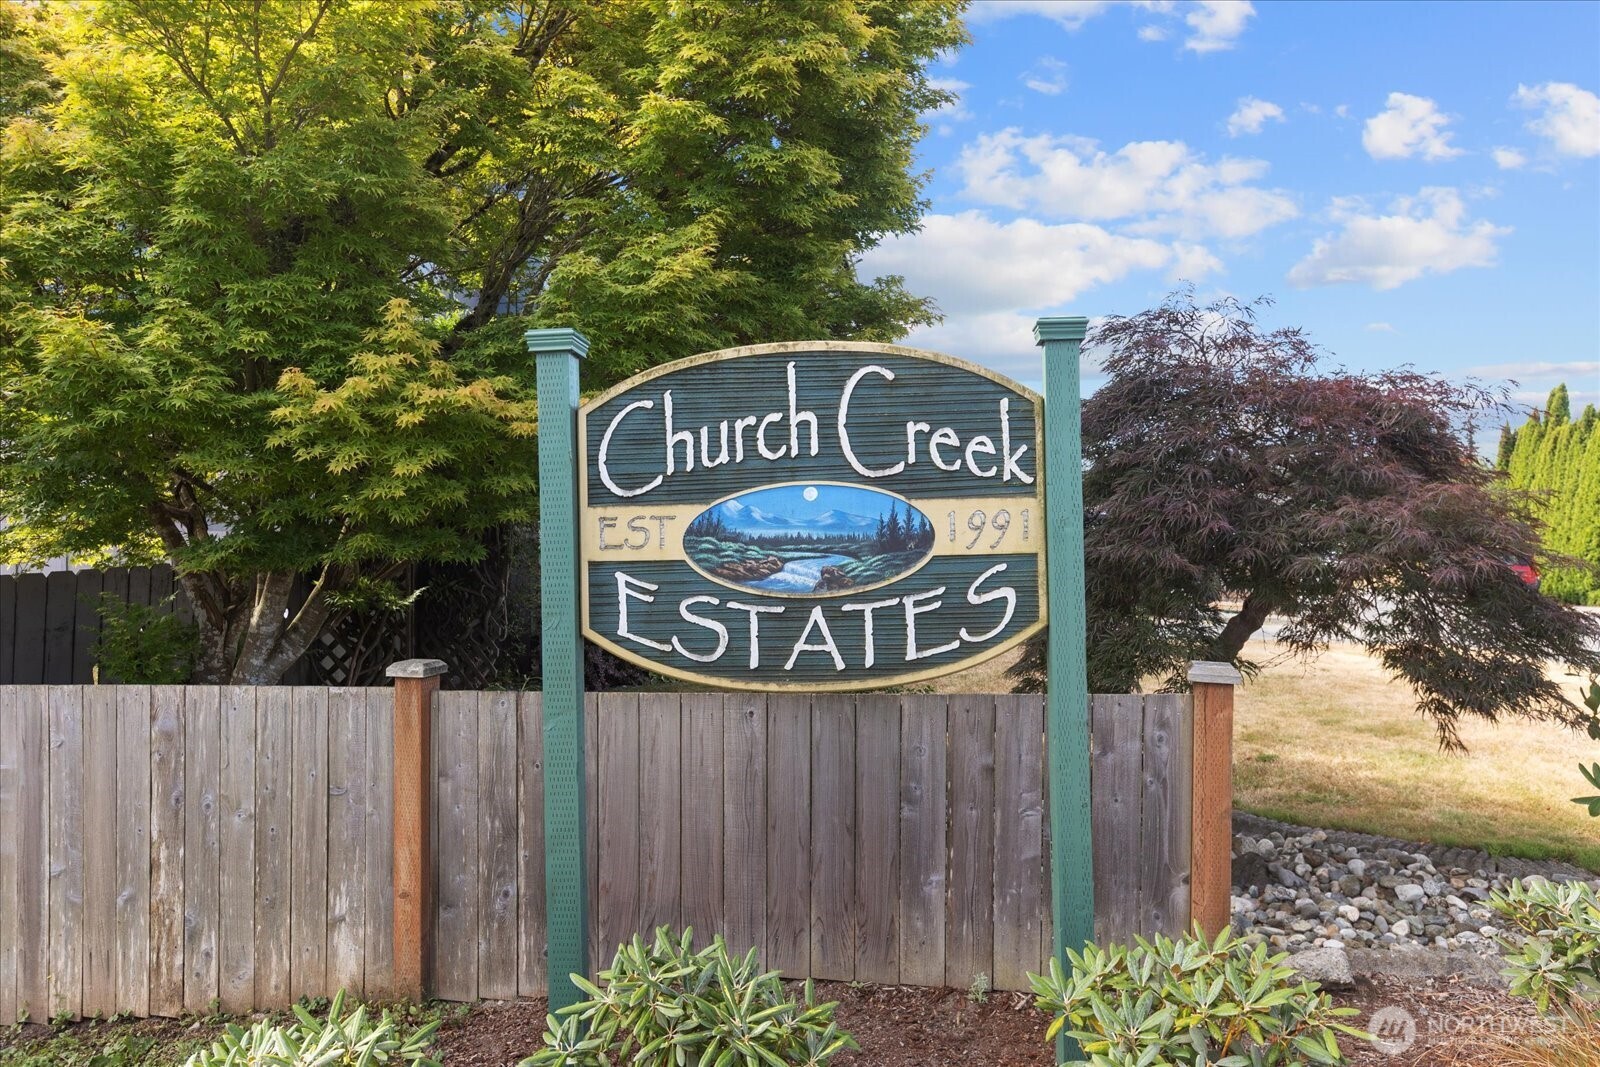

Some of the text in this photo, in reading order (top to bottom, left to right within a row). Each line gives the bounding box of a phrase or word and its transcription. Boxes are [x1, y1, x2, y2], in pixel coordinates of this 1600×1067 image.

[598, 361, 1035, 498] Church Creek
[598, 508, 1029, 550] EST 1991
[614, 563, 1017, 671] ESTATES
